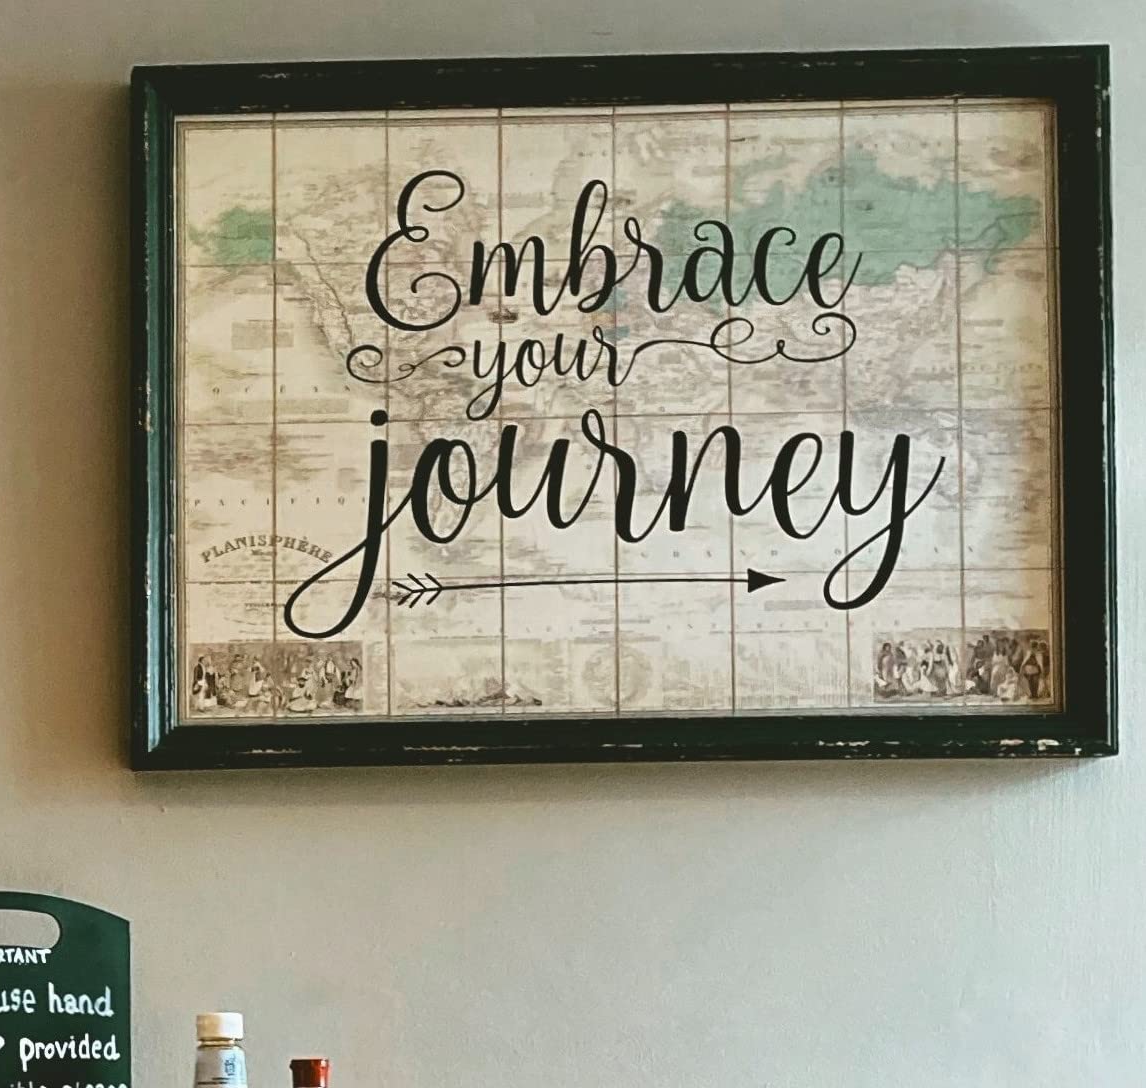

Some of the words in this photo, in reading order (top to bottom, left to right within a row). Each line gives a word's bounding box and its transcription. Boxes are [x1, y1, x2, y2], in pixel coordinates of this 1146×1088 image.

[365, 169, 864, 331] Embrace
[466, 326, 632, 421] your
[283, 408, 946, 639] journey
[48, 982, 115, 1018] hand
[19, 1032, 122, 1073] provided
